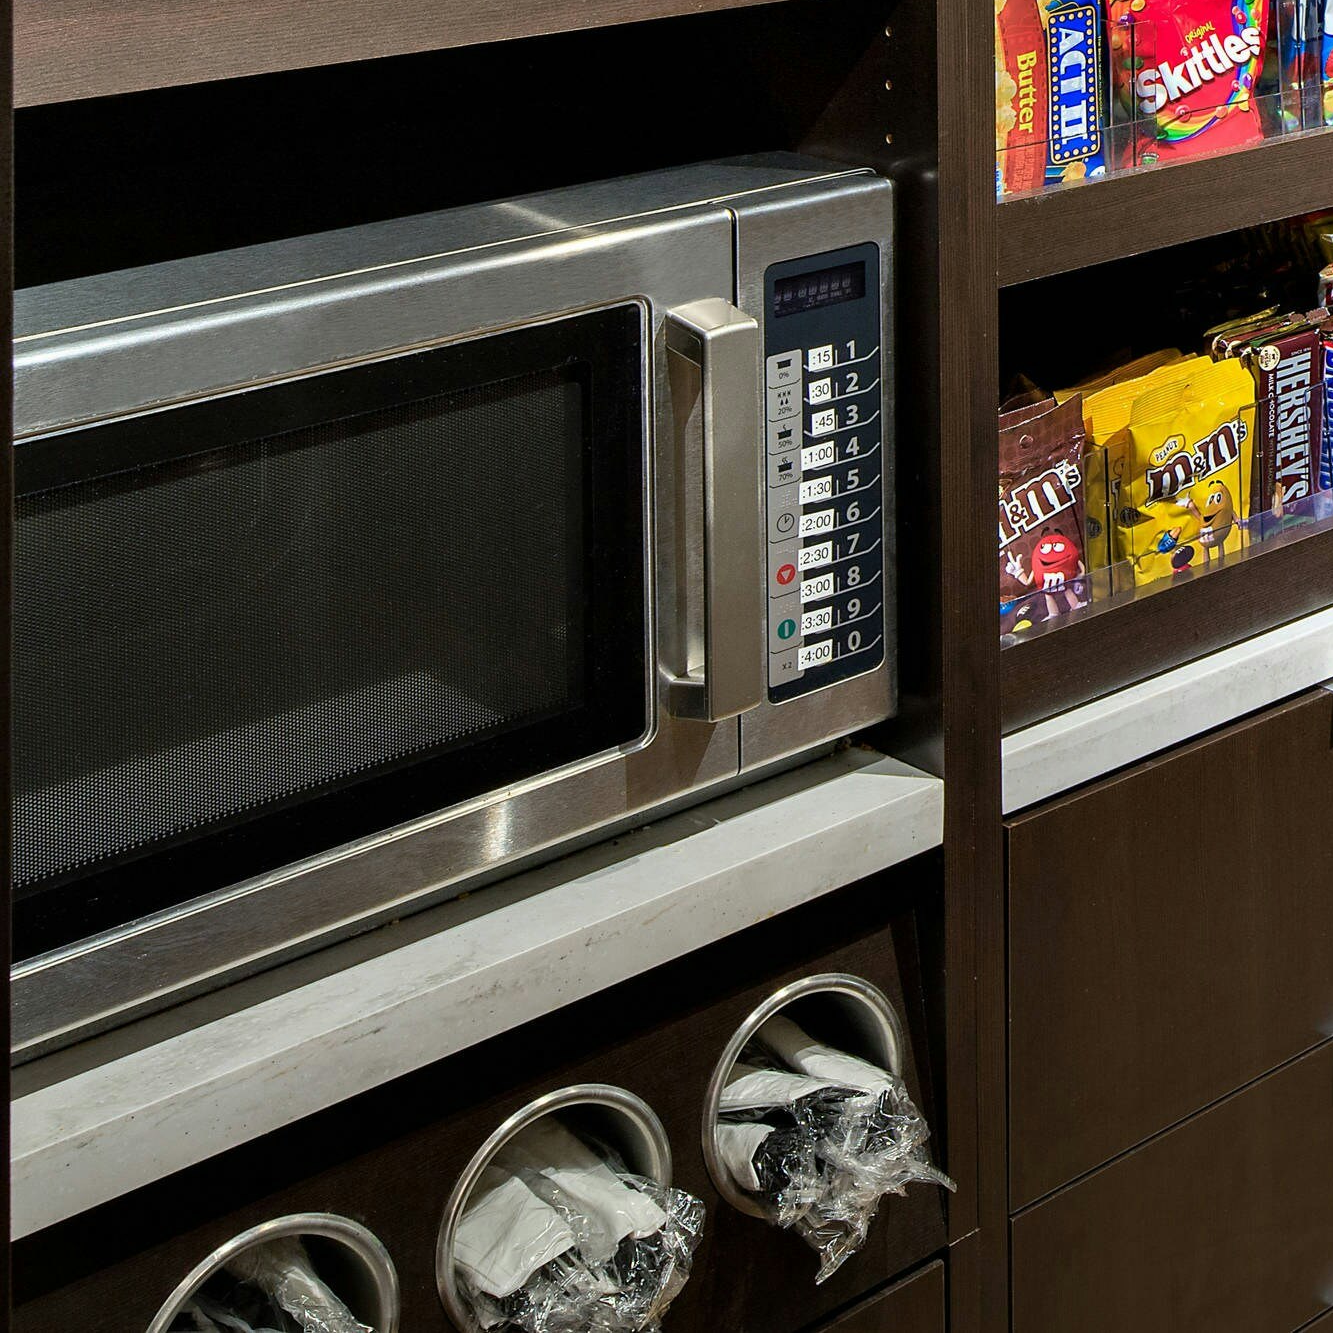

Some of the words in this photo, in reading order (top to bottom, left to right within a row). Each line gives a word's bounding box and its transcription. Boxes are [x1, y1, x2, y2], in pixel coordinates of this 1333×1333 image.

[1058, 27, 1087, 95] ACT
[1136, 26, 1262, 115] Skittles
[1016, 49, 1037, 133] Butter
[812, 350, 831, 366] :15
[846, 339, 856, 359] 1
[811, 382, 830, 399] :30
[846, 372, 859, 393] 2
[815, 414, 833, 429] :45
[846, 404, 859, 425] 3
[1275, 350, 1312, 505] HERSHEY'S
[804, 446, 833, 465] :1:00
[845, 436, 860, 456] 4
[802, 480, 831, 498] :1:30
[847, 468, 859, 490] 5
[846, 501, 860, 522] 6
[802, 514, 831, 532] :2:00
[847, 533, 860, 554] 7
[847, 566, 860, 586] 8
[847, 598, 861, 619] 9
[847, 630, 861, 651] 0
